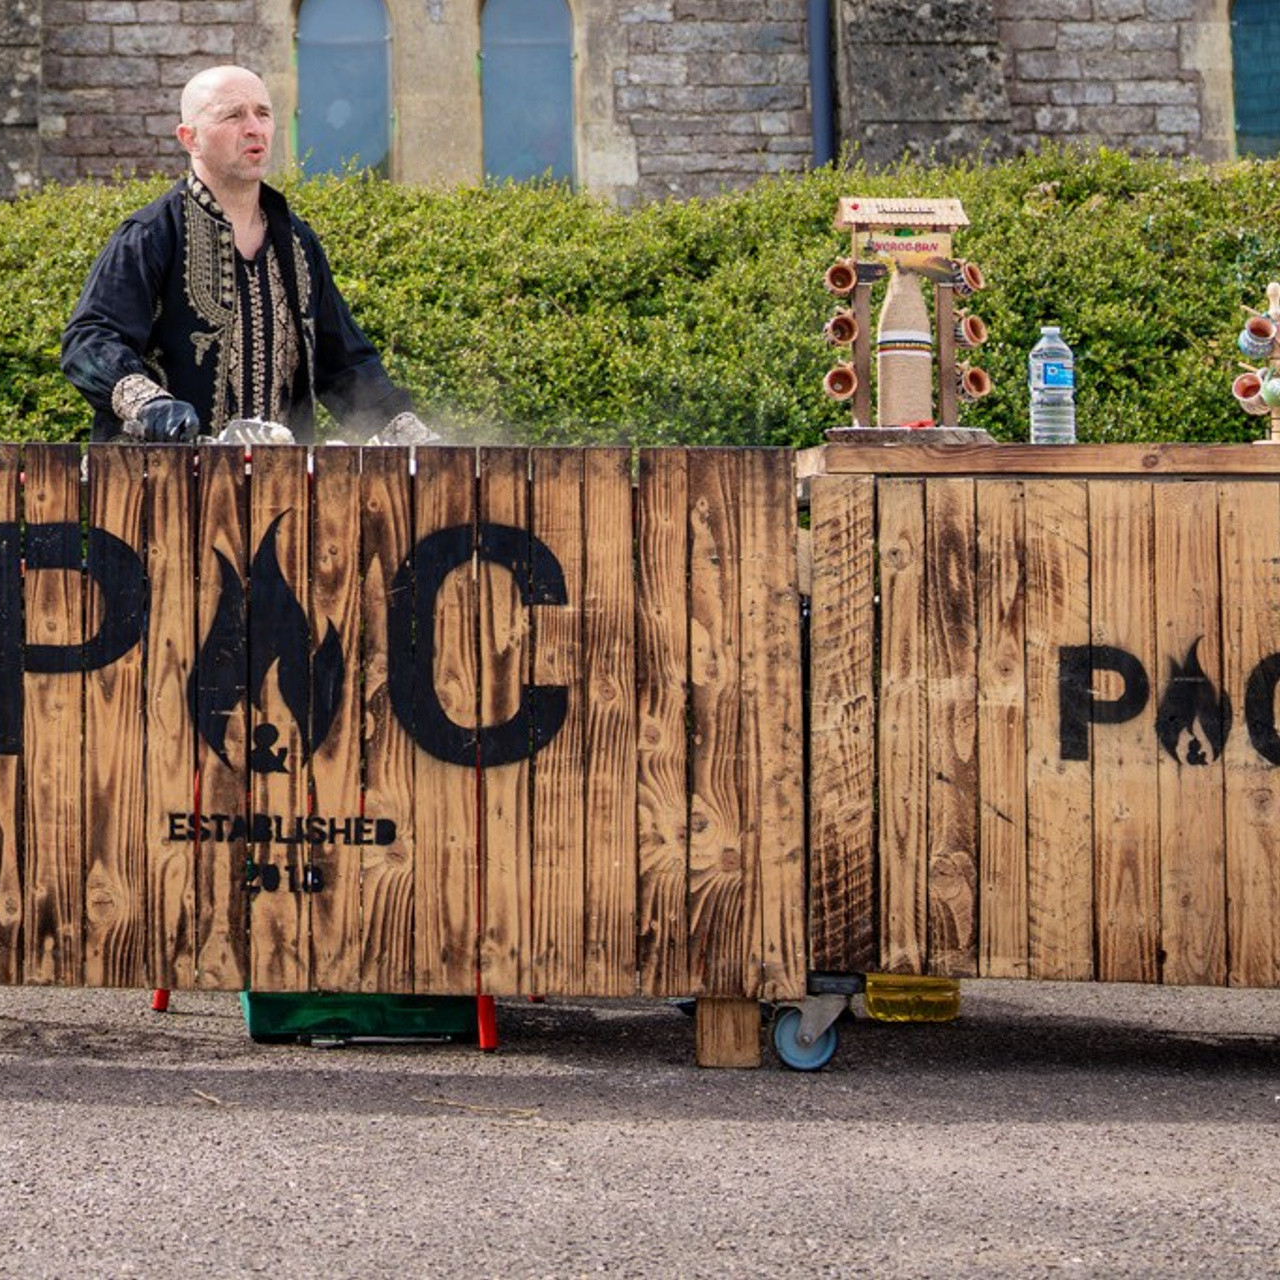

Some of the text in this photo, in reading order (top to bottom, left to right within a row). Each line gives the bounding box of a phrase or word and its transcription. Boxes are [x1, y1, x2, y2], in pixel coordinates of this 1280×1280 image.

[250, 723, 291, 774] &
[387, 523, 569, 768] C
[1059, 644, 1150, 761] P
[168, 813, 397, 846] ESTABLISHED
[241, 864, 325, 893] 2018
